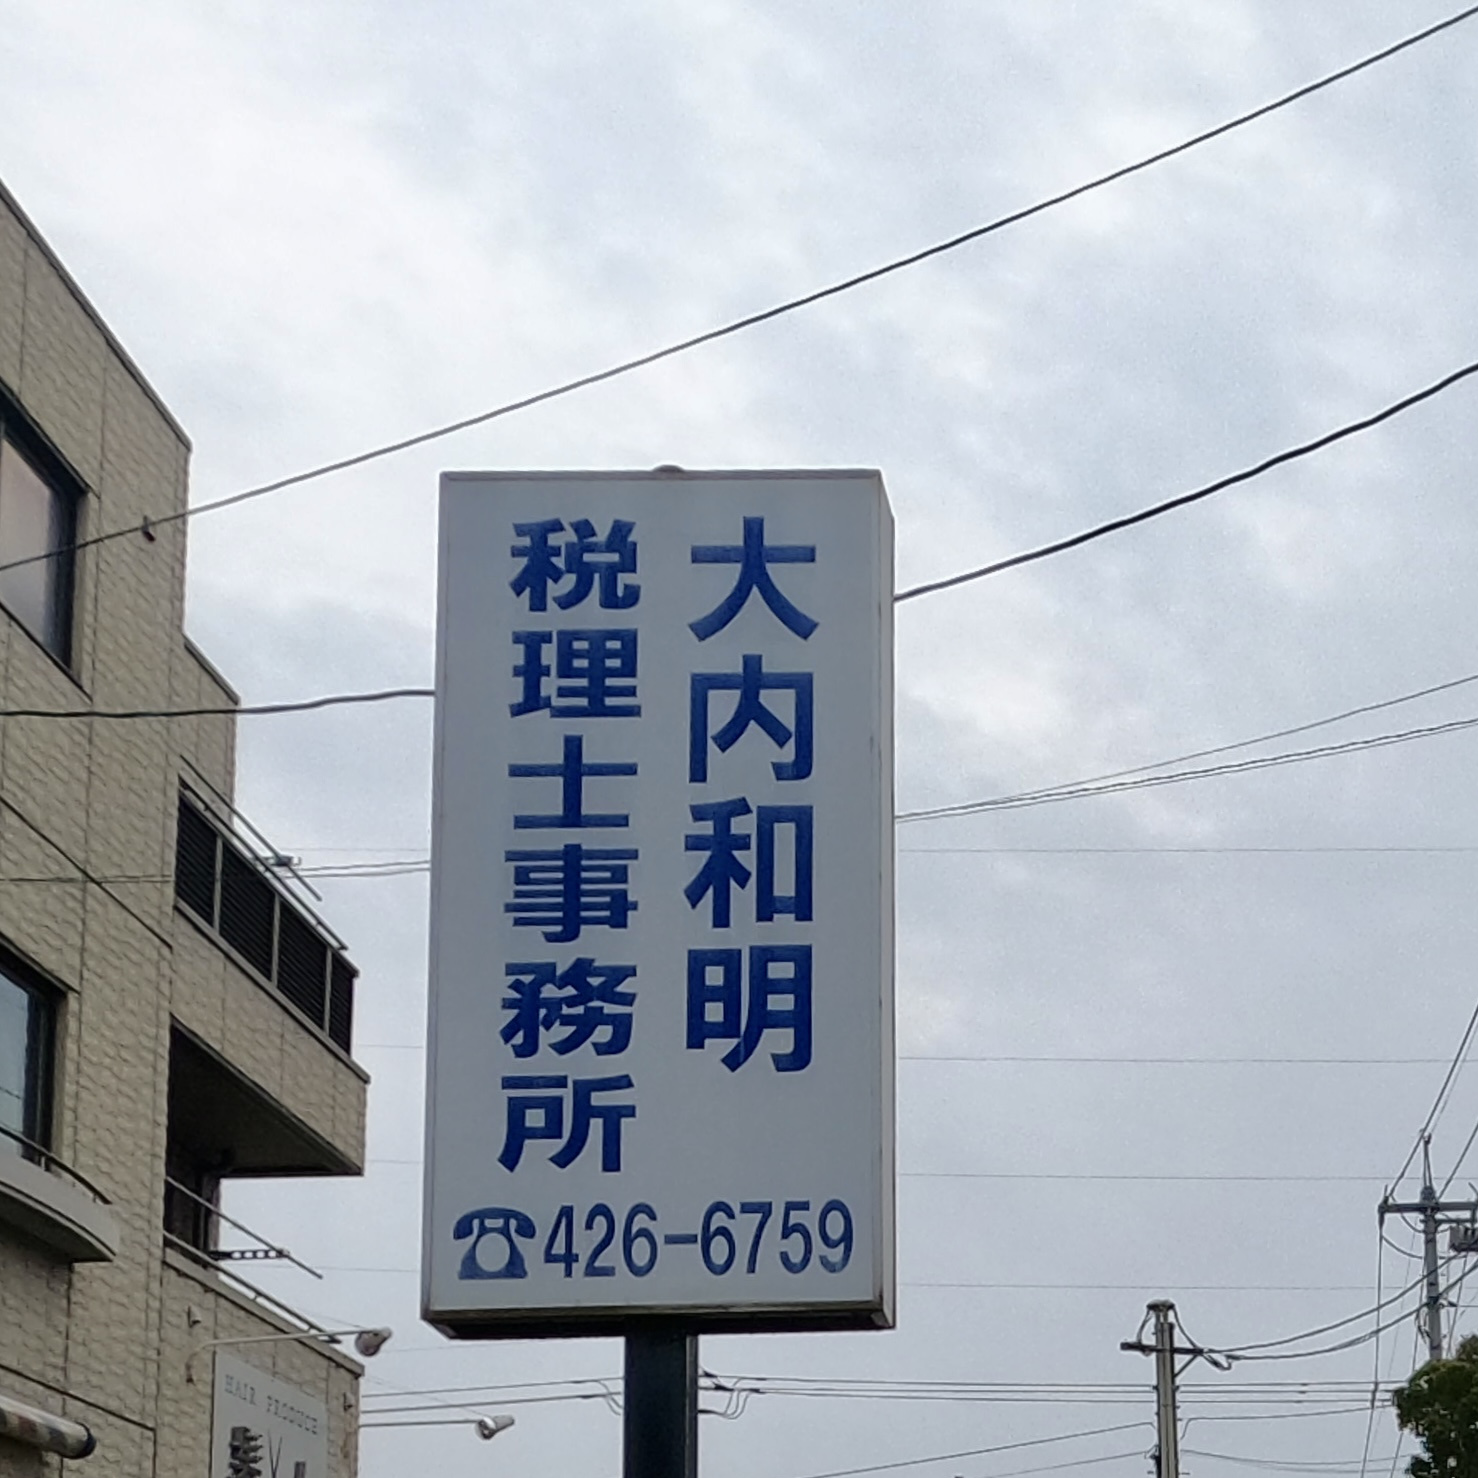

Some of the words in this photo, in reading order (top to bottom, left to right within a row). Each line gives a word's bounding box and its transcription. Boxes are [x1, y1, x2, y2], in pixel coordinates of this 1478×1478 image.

[497, 517, 642, 1174] 税理士事務所
[683, 515, 819, 1074] 大内和明
[543, 1199, 855, 1279] 426-6759
